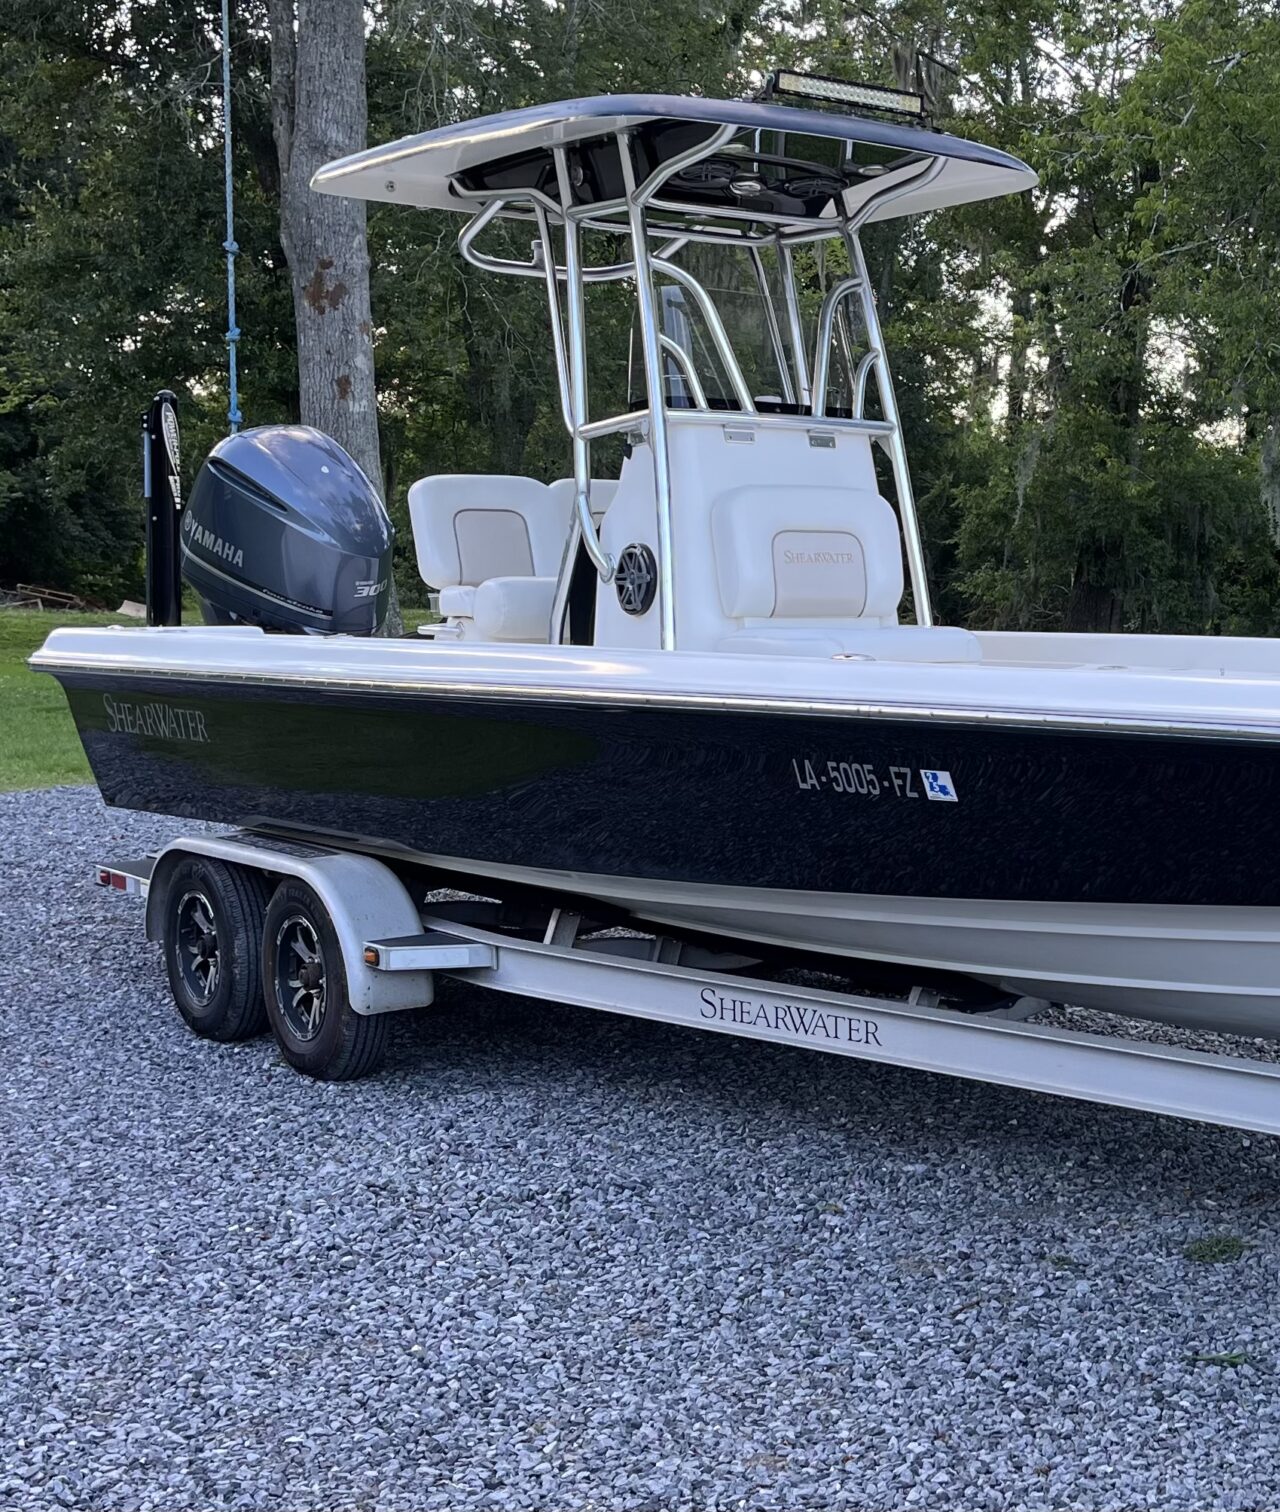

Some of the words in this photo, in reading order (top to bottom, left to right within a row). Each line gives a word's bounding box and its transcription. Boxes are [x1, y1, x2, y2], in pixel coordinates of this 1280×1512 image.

[190, 518, 243, 567] YAMAHA
[354, 579, 388, 597] 300
[700, 987, 882, 1047] SHEARWATER
